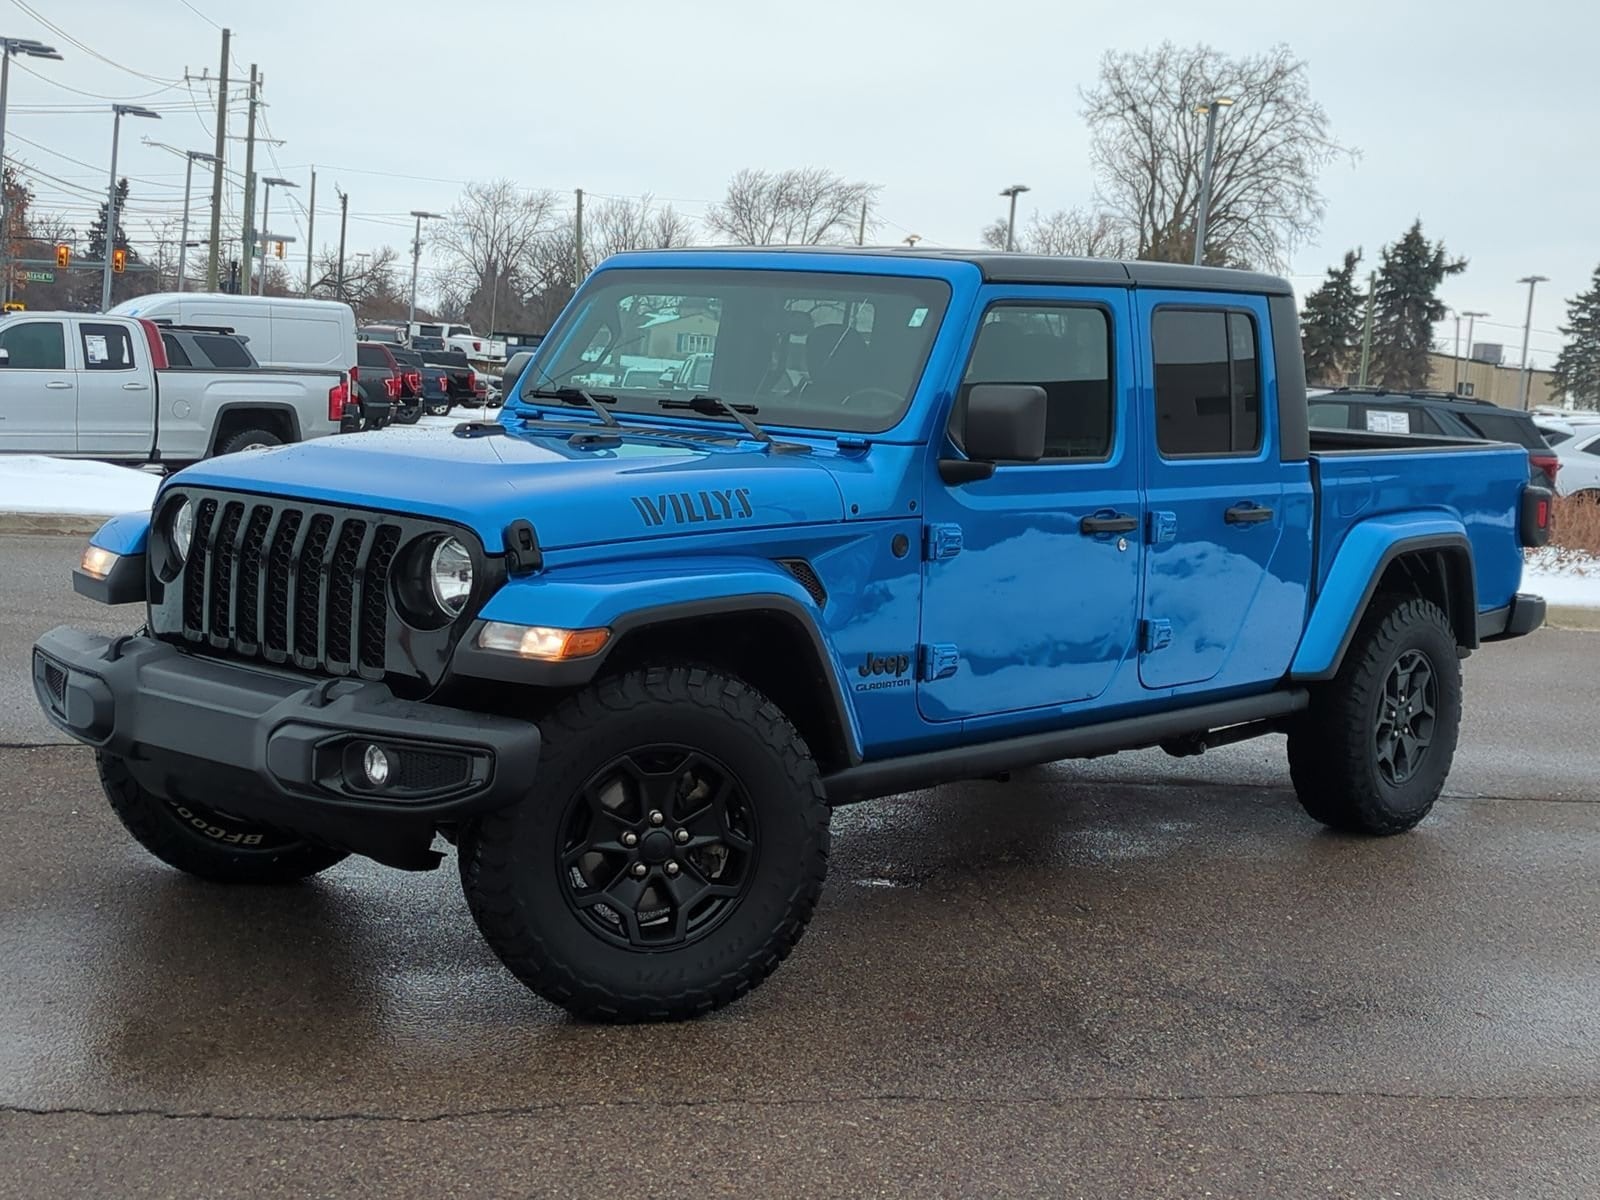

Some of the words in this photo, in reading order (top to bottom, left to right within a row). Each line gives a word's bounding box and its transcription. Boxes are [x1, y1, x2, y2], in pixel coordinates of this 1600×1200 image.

[631, 488, 753, 526] WILLYS
[858, 652, 910, 677] Jeep
[855, 678, 911, 692] GLADIATOR
